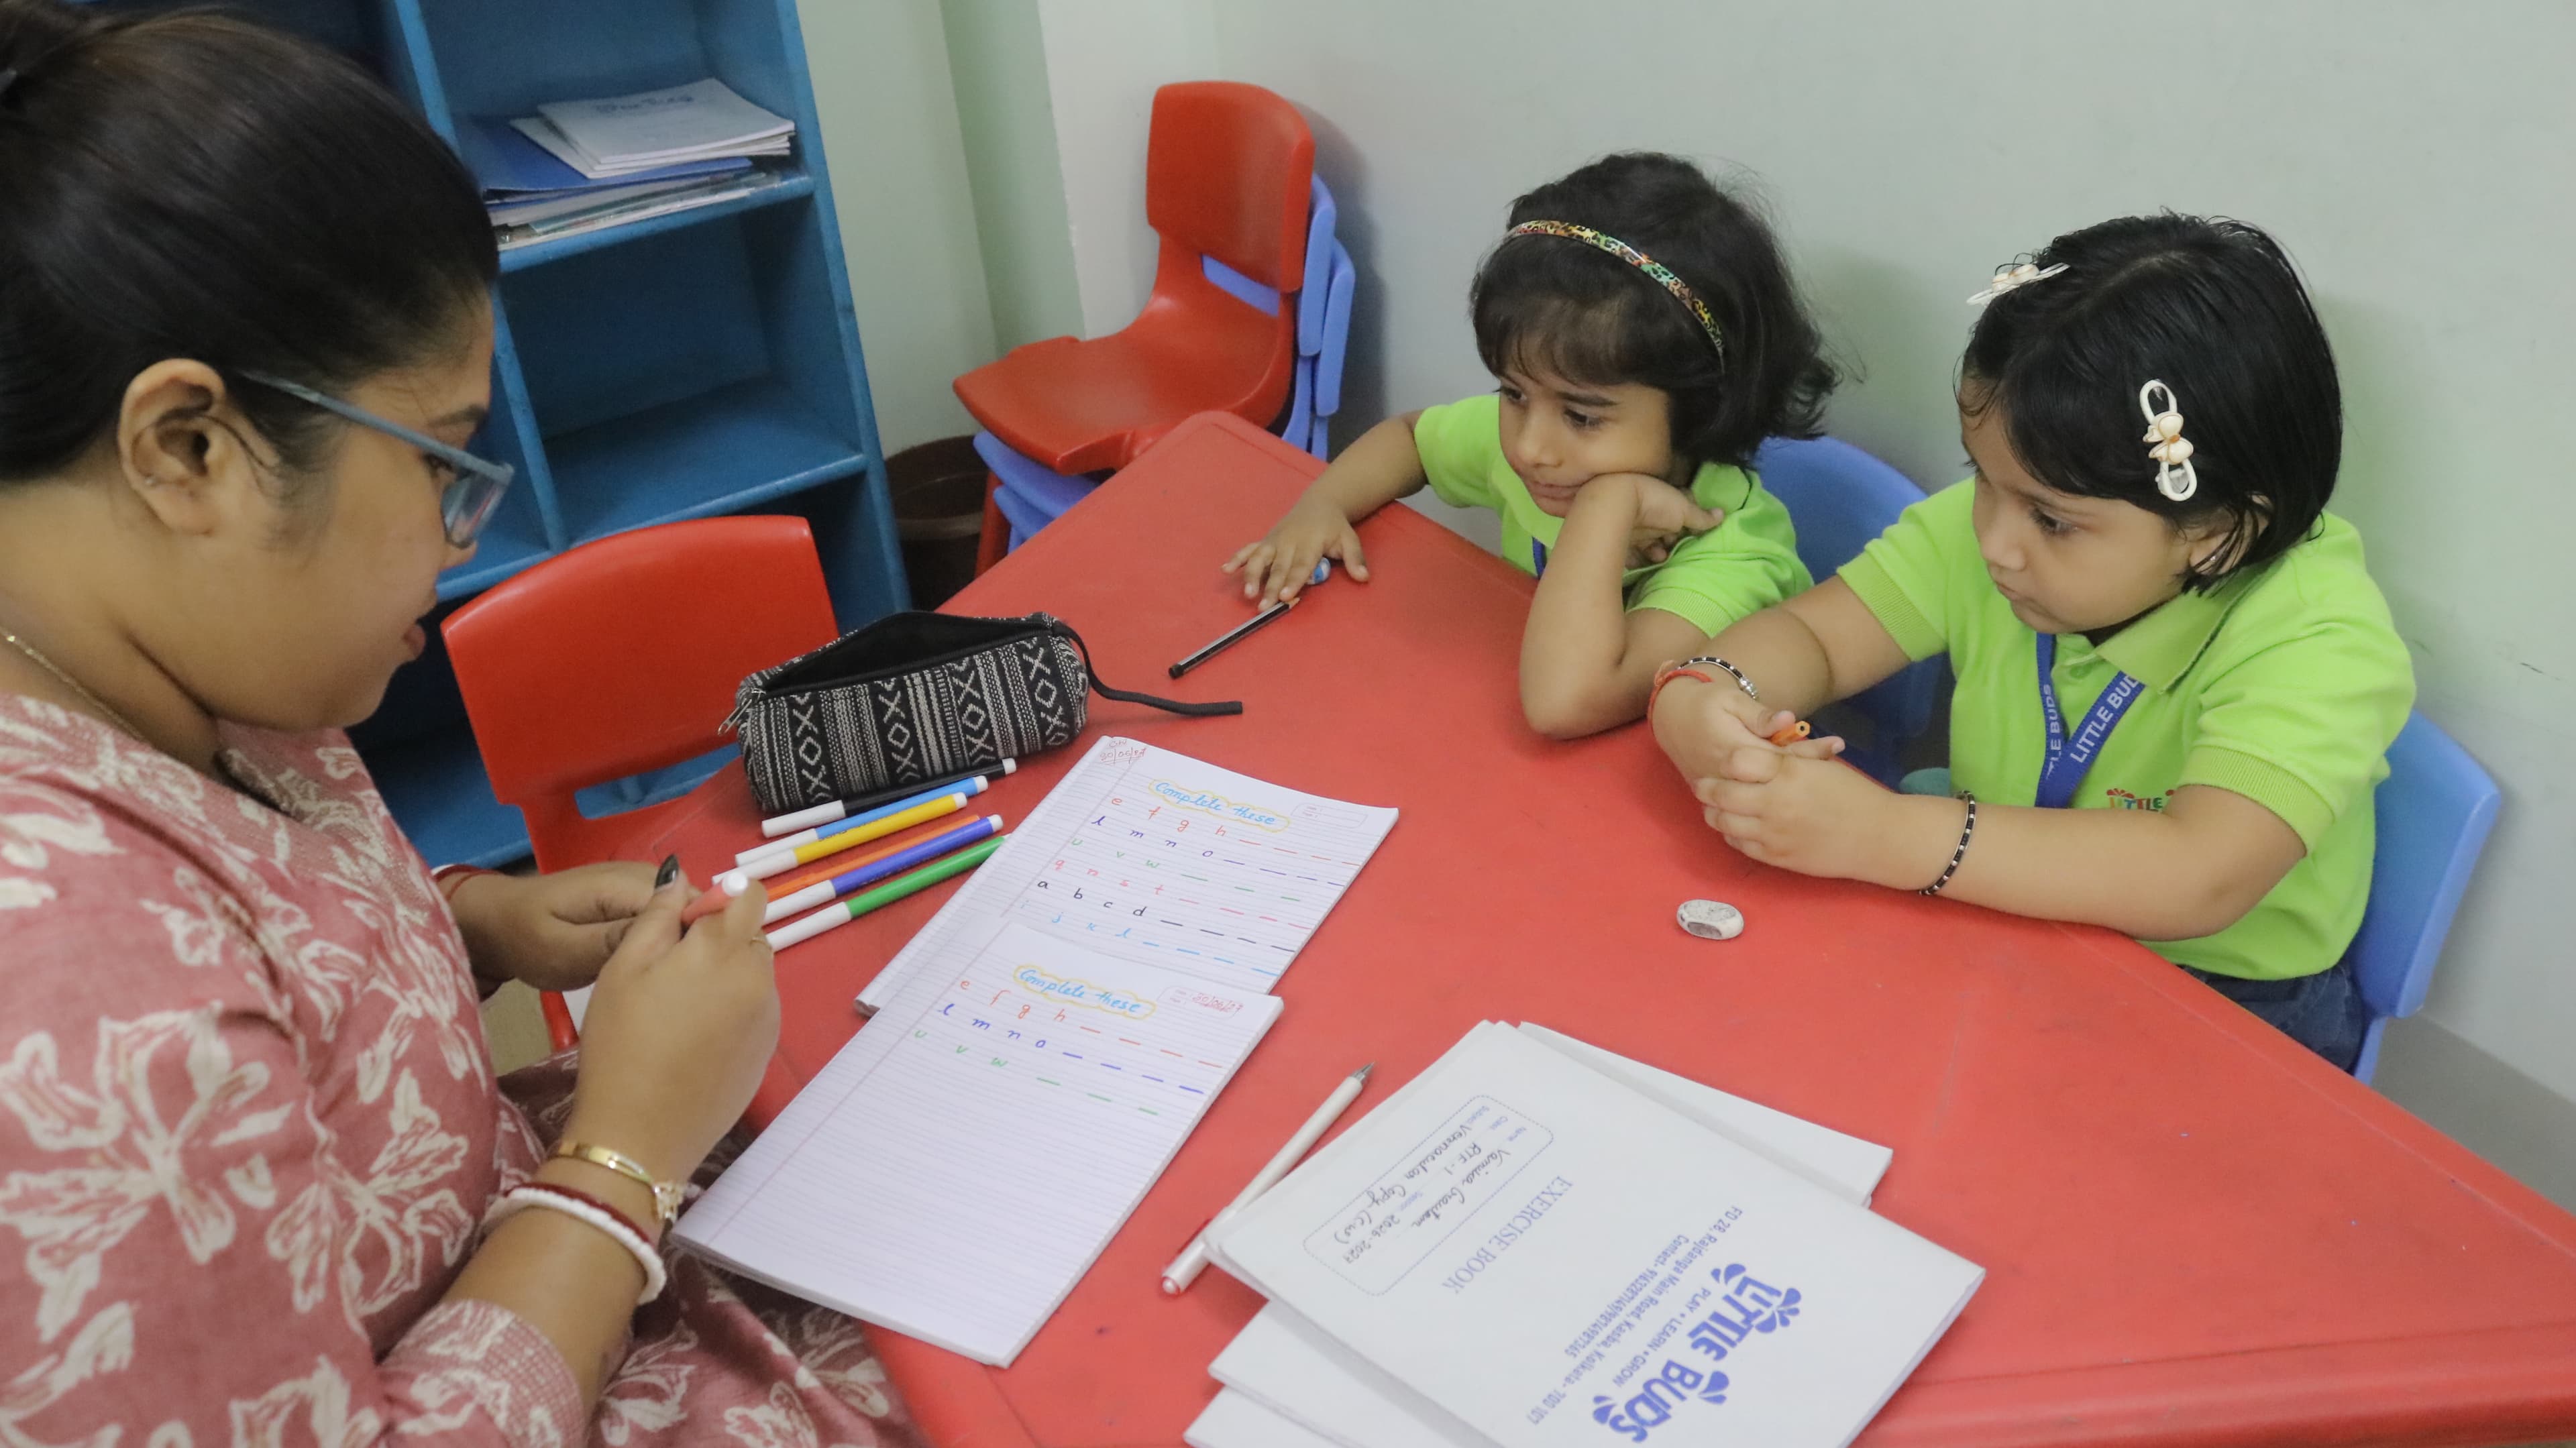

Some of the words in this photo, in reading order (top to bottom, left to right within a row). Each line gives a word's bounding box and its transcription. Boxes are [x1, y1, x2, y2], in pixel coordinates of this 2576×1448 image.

[2043, 683, 2061, 734] BUDS
[2070, 706, 2114, 763] LITTLE
[1111, 797, 1122, 805] e
[1148, 806, 1161, 820] f
[1177, 820, 1189, 832] g
[1215, 825, 1226, 836] h
[1155, 782, 1223, 811] Complete
[1232, 806, 1276, 824] these
[1130, 829, 1144, 838] m
[1164, 839, 1177, 848] n
[1055, 859, 1065, 871] q
[1154, 884, 1165, 895] t
[1116, 850, 1126, 858] v
[1145, 859, 1160, 869] w
[1037, 881, 1049, 889] a
[1073, 887, 1083, 899] b
[1132, 906, 1147, 917] d
[1051, 911, 1064, 924] j
[960, 980, 970, 990] e
[989, 989, 1012, 1006] f
[1017, 1004, 1031, 1019] g
[1053, 1008, 1066, 1022] h
[1019, 969, 1085, 998] Complete
[1094, 991, 1141, 1012] these
[914, 1029, 928, 1039] u
[955, 1045, 969, 1054] v
[990, 1057, 1008, 1067] w
[971, 1019, 991, 1030] m
[1008, 1029, 1021, 1040] n
[1034, 1040, 1046, 1048] o
[1366, 1185, 1406, 1207] Copy
[1489, 1177, 1573, 1250] EXERCISE
[1442, 1247, 1496, 1294] BOOK
[1673, 1233, 1717, 1274] Rajdanga
[1653, 1273, 1680, 1296] Main
[1685, 1288, 1711, 1313] PLAY
[1647, 1318, 1682, 1351] LEARN
[1687, 1276, 1782, 1361] LITTLE
[1613, 1355, 1646, 1387] GROW
[1527, 1407, 1548, 1425] 107
[1542, 1390, 1566, 1408] 700
[1609, 1359, 1703, 1443] BUDS
